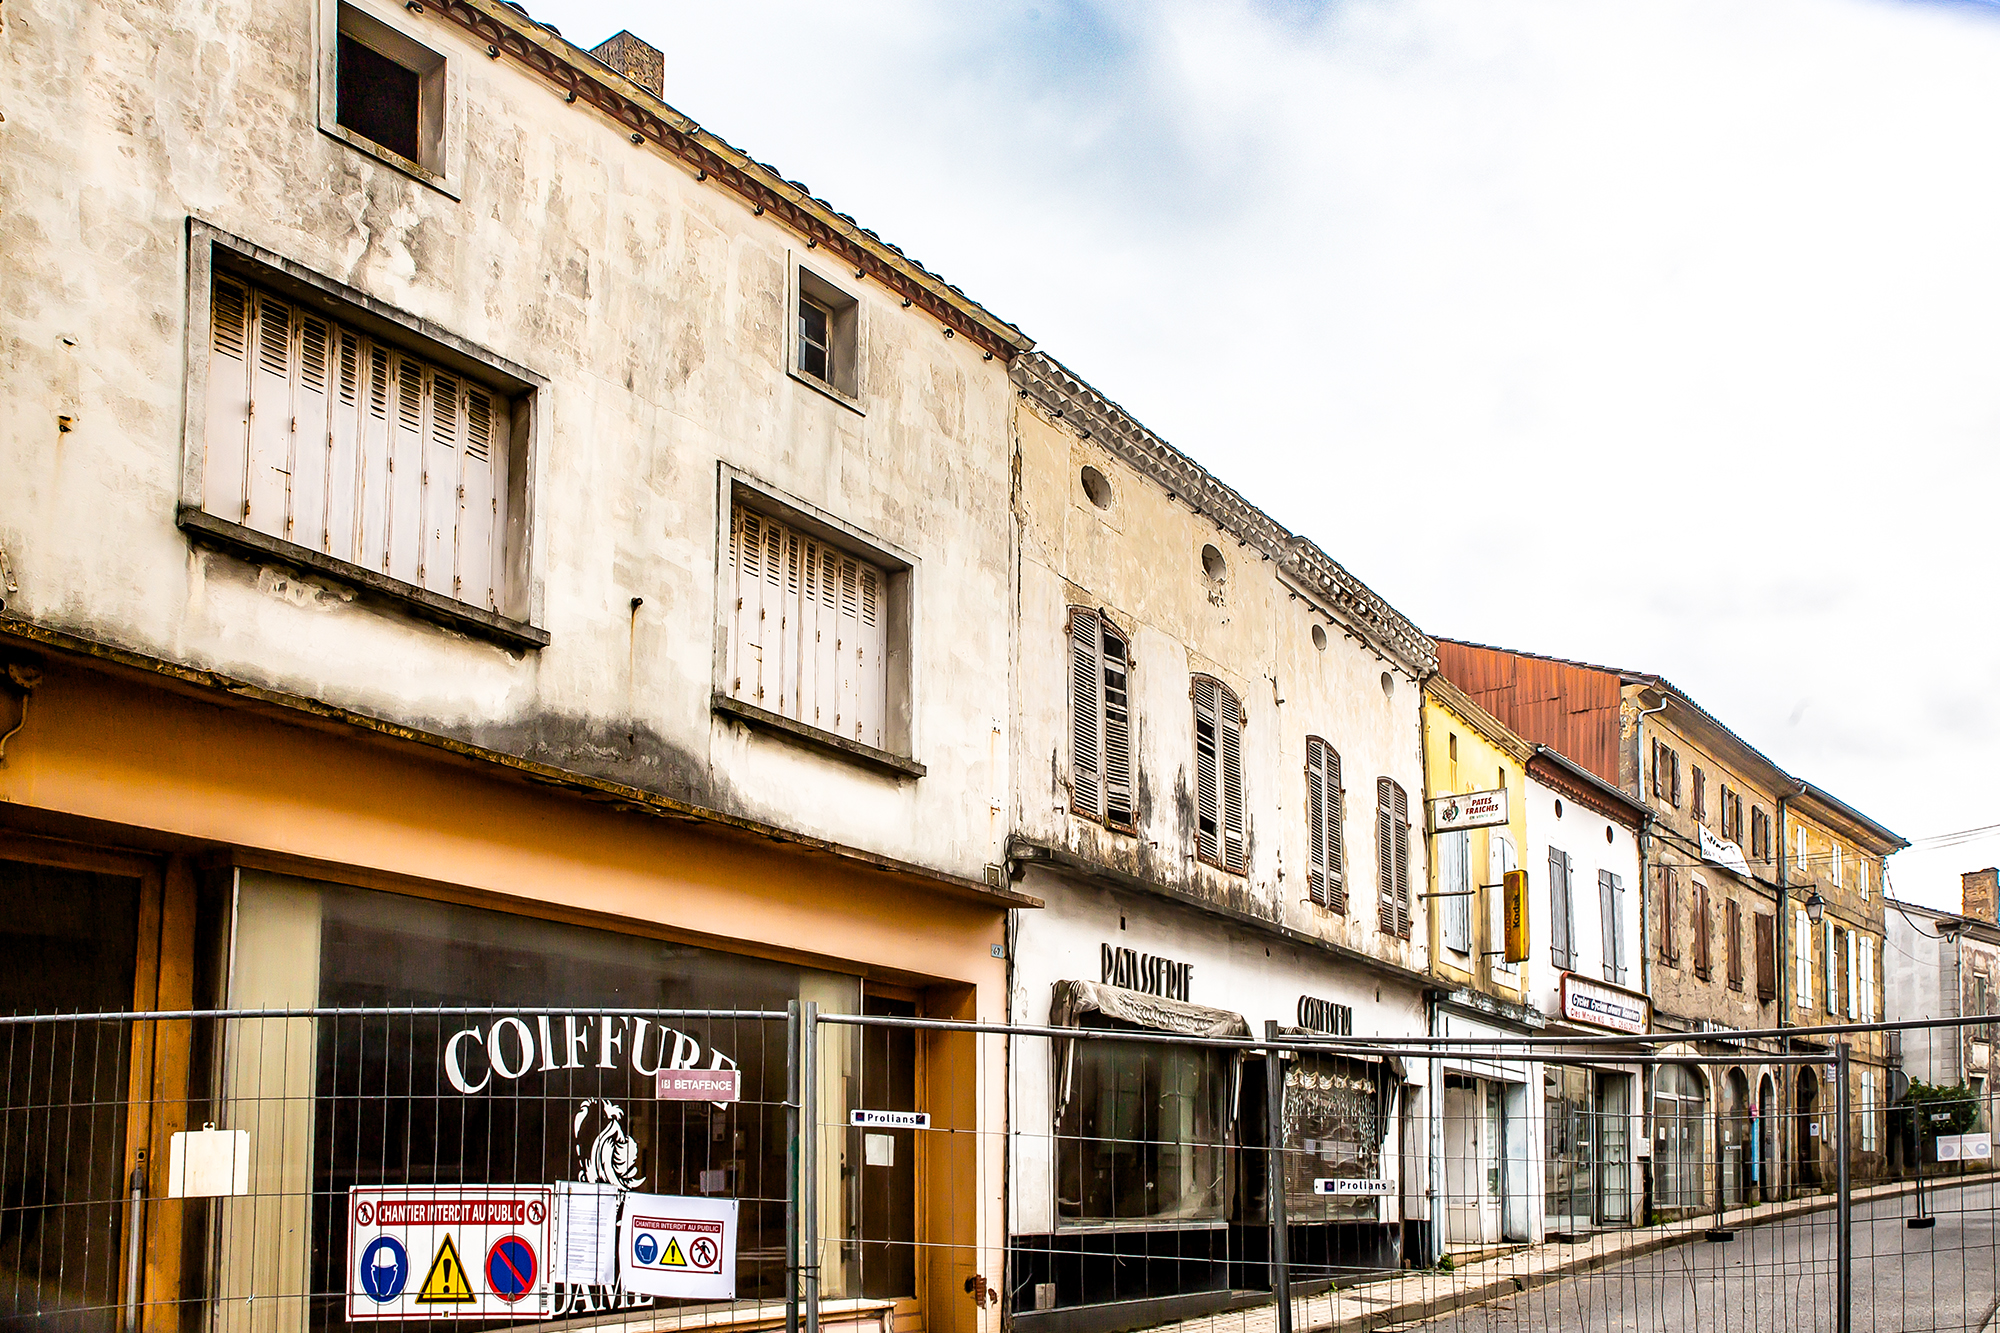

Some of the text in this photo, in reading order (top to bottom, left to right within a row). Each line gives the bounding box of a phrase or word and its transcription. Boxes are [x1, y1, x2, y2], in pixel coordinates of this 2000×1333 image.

[1472, 797, 1492, 806] PATES
[1465, 804, 1499, 815] FRAICHES
[1101, 943, 1194, 1002] PATISSERIE
[674, 1079, 732, 1091] BETAFENCE
[867, 1113, 915, 1123] Prolians
[1340, 1181, 1387, 1190] Prolians
[379, 1204, 523, 1222] CHANTIER INTERDIT AU PUBLIC
[635, 1219, 719, 1233] CHANTIER INTERDIT AU PUBLIC
